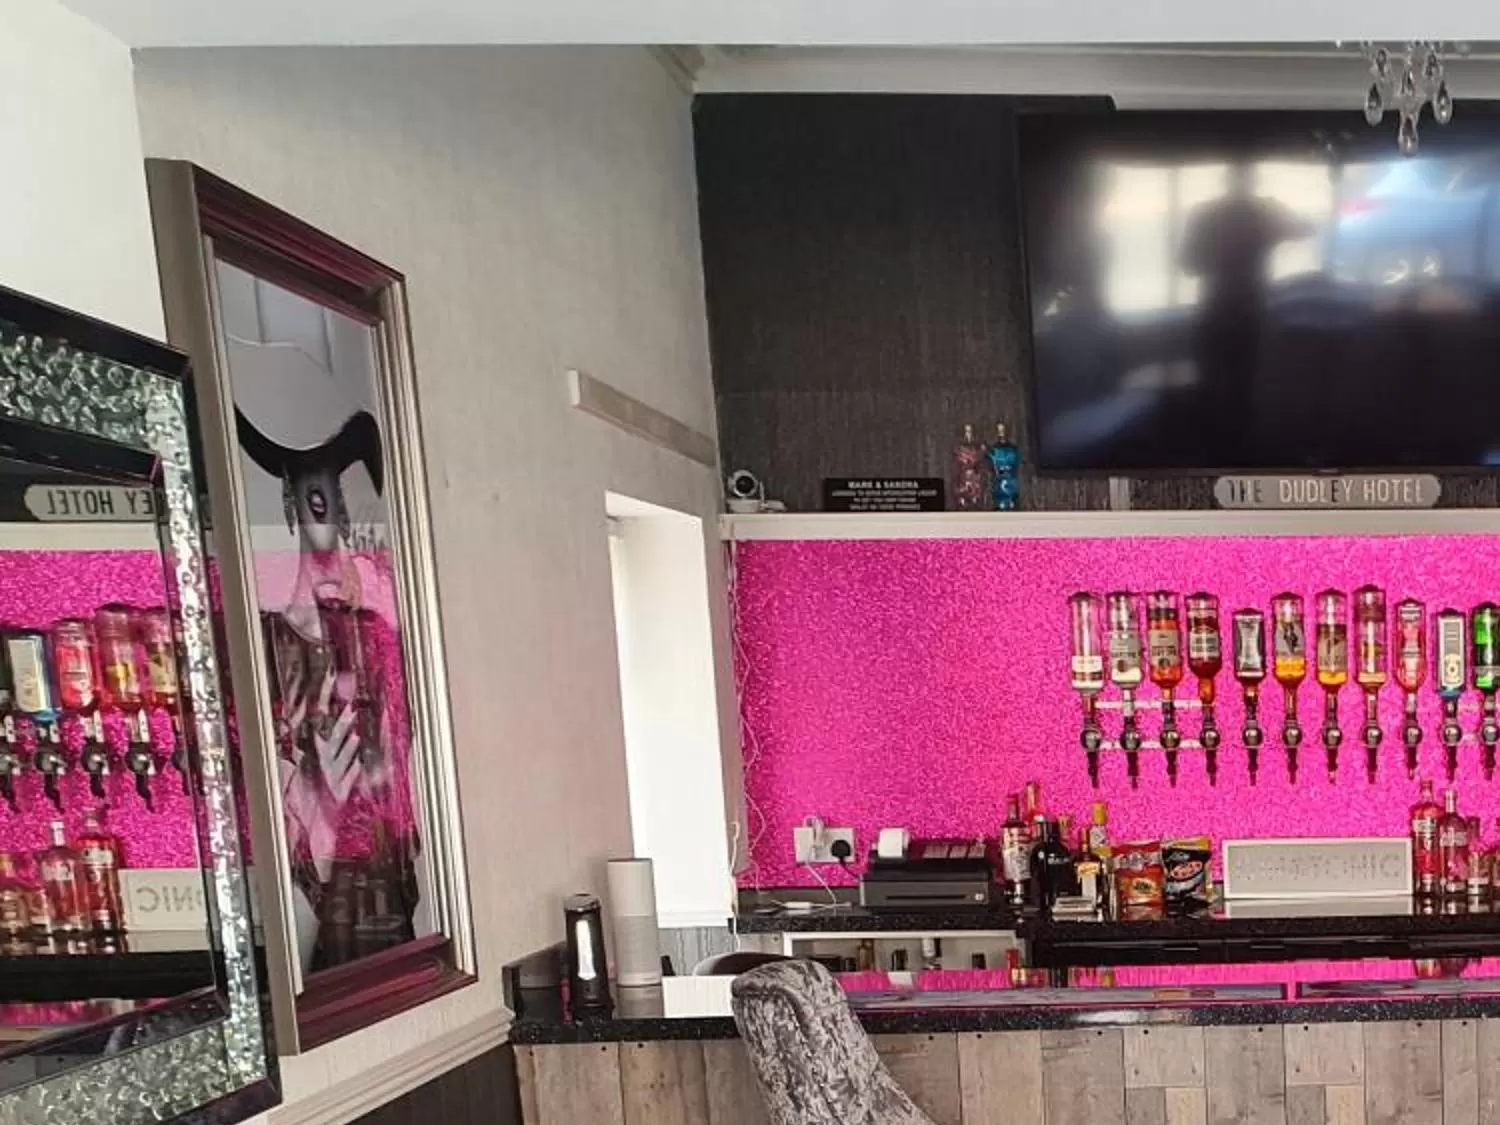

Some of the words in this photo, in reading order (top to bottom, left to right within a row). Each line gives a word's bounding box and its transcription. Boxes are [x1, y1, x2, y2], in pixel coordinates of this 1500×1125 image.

[1227, 479, 1264, 503] THE
[1279, 479, 1354, 503] DUDLEY
[1363, 478, 1423, 502] HOTEL
